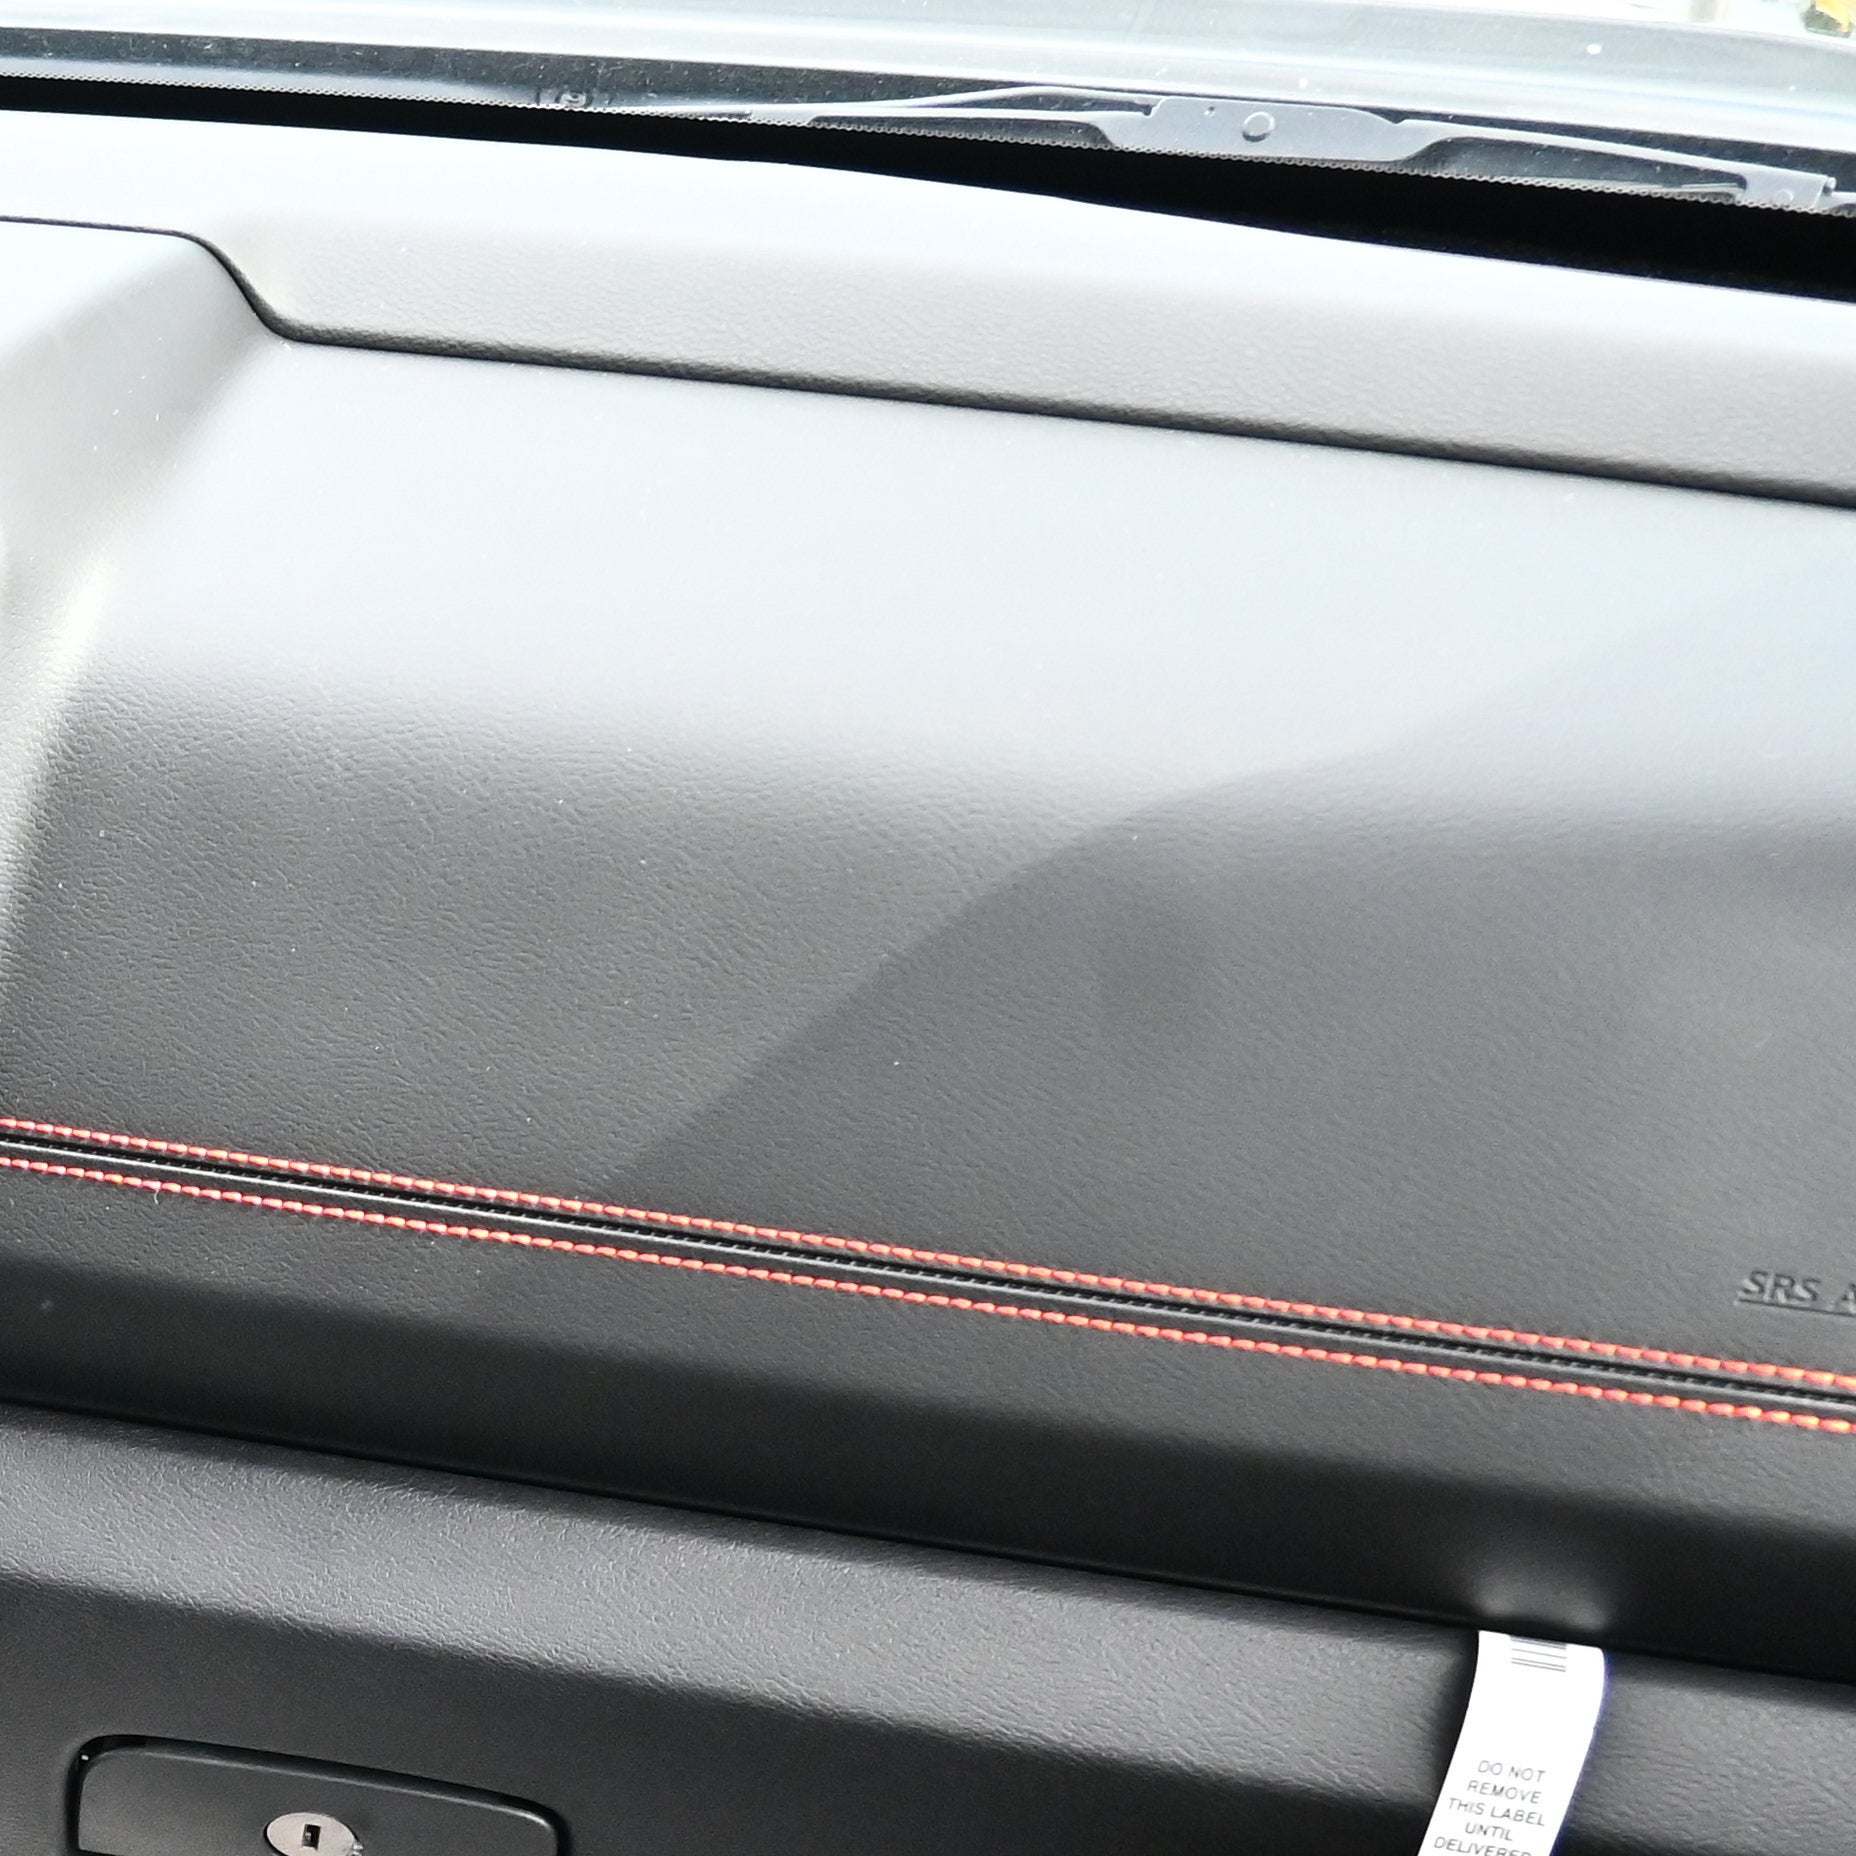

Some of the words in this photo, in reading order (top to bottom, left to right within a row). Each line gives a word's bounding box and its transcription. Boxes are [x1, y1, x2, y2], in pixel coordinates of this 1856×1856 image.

[1746, 1270, 1822, 1302] SRS
[1478, 1760, 1503, 1776] DO
[1510, 1766, 1546, 1783] NOT
[1467, 1780, 1542, 1805] REMOVE
[1448, 1797, 1484, 1816] THIS
[1490, 1805, 1545, 1827] LABEL
[1465, 1822, 1513, 1841] UNTIL
